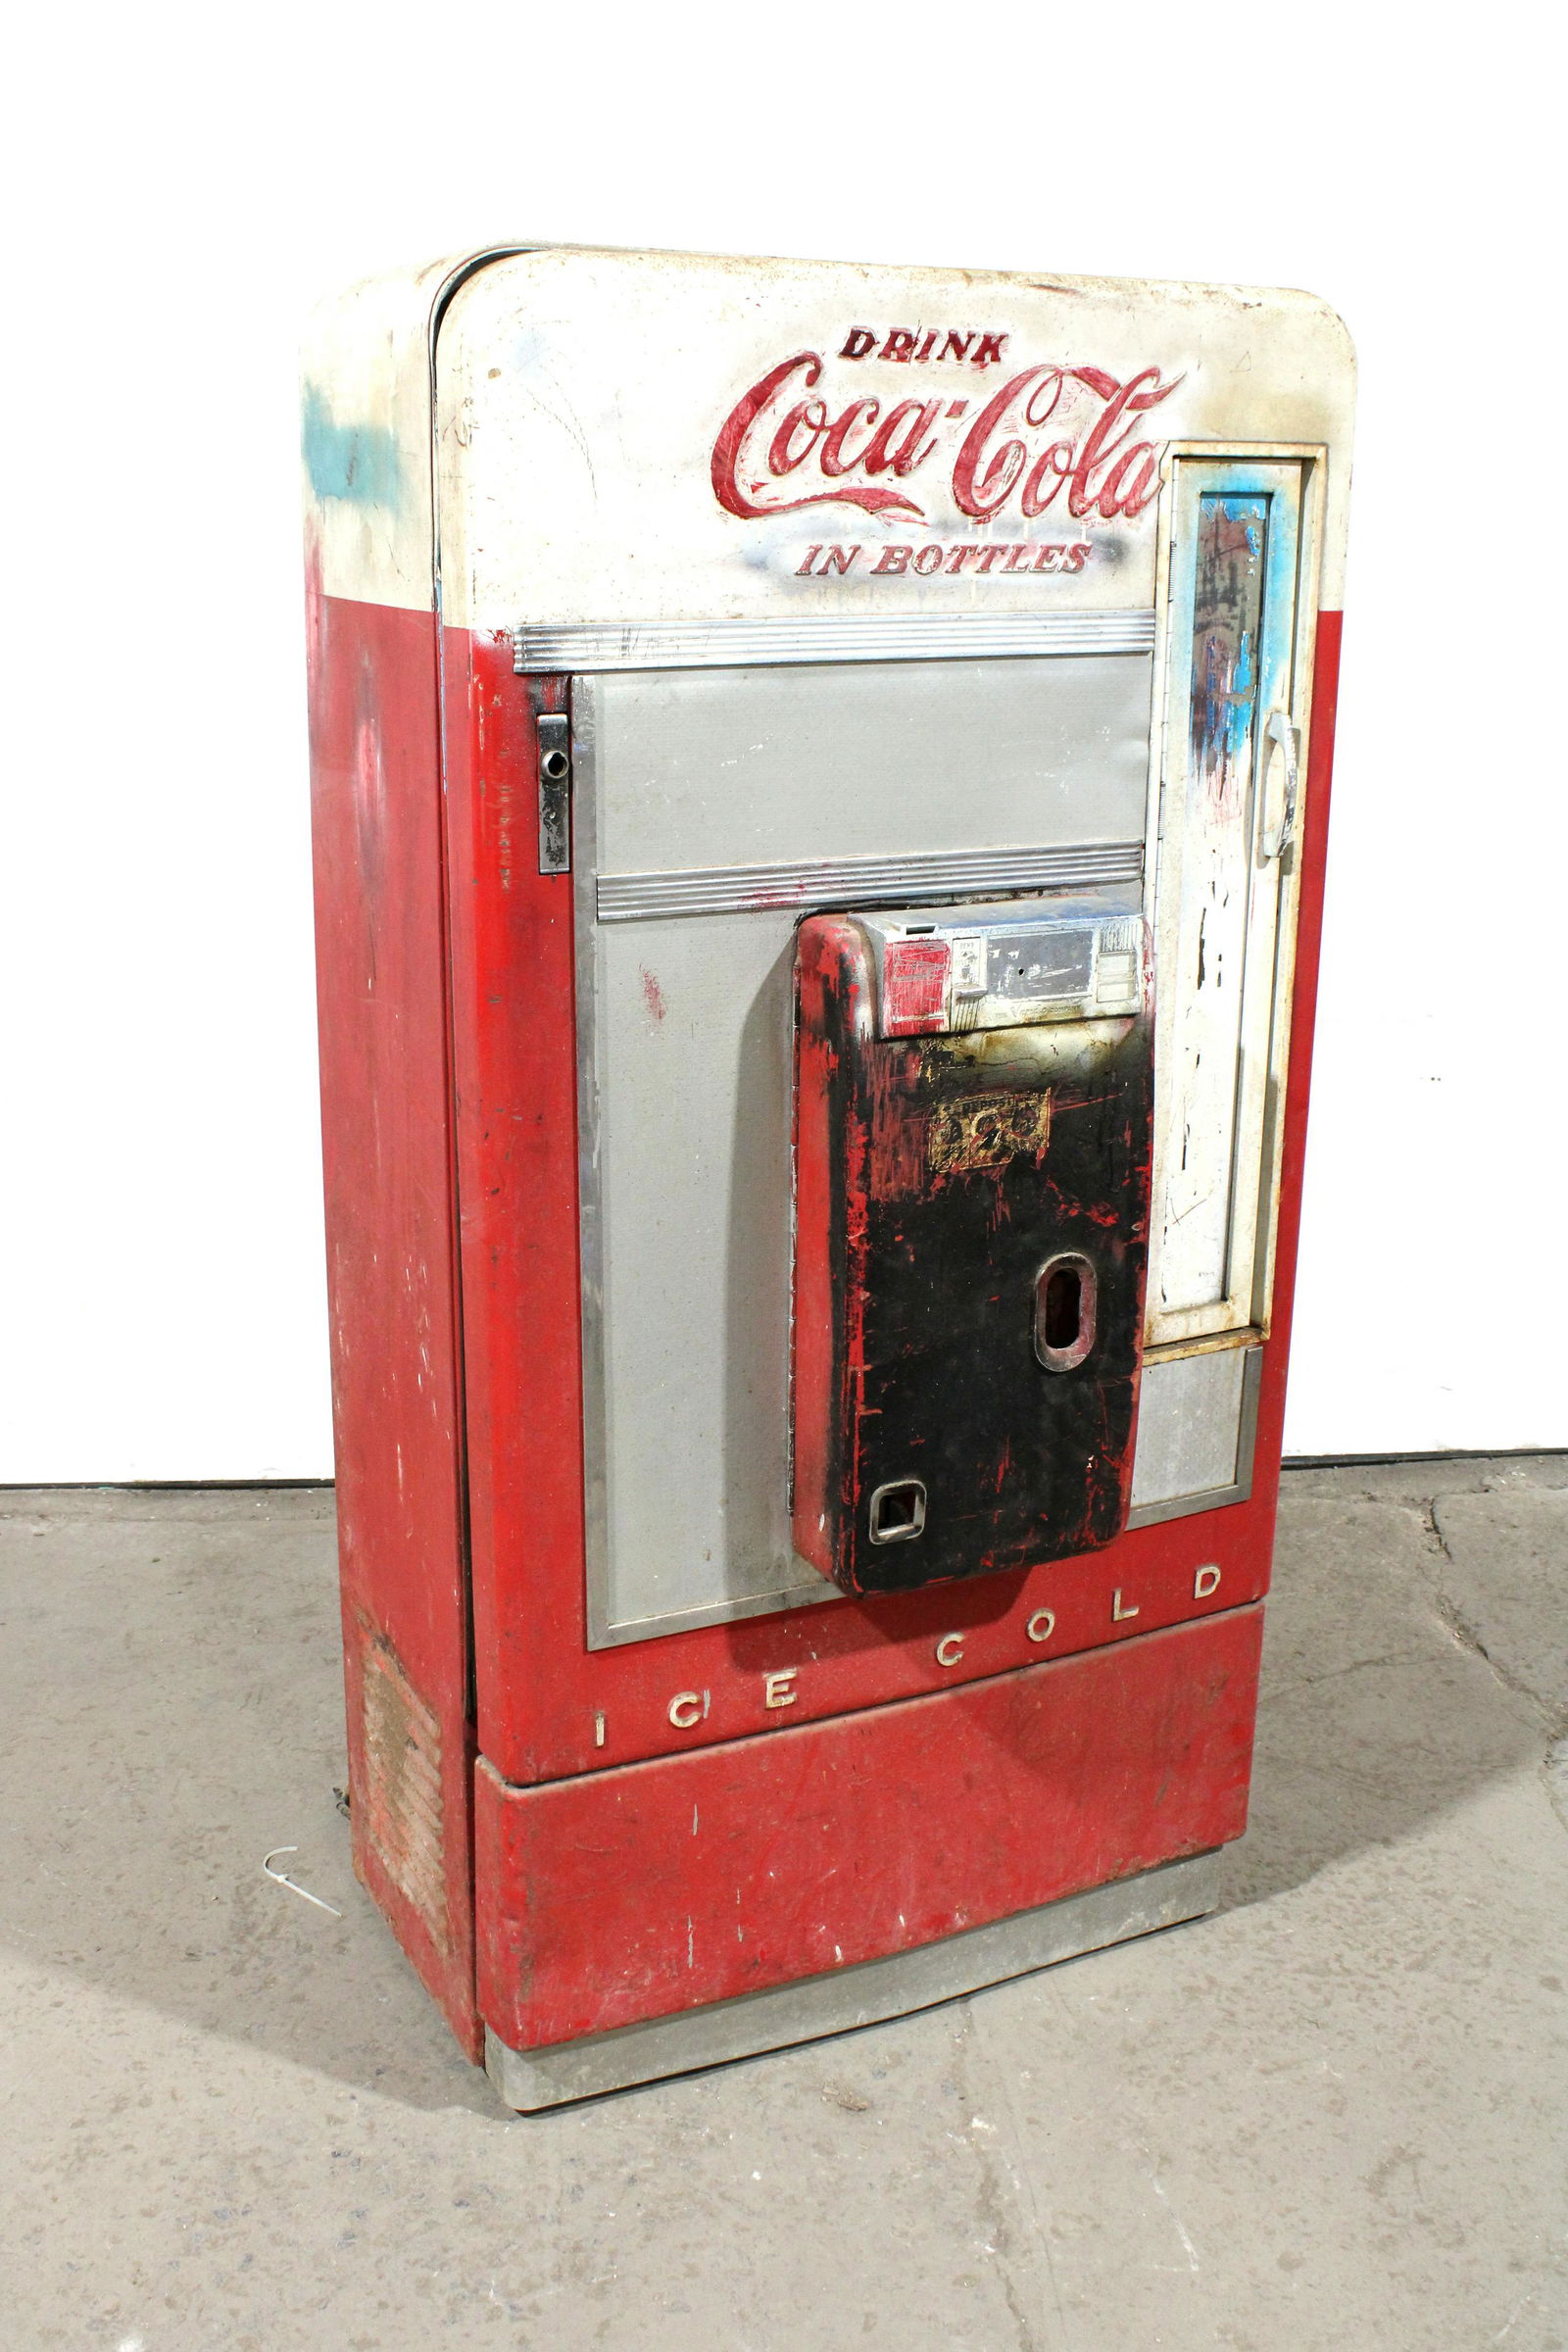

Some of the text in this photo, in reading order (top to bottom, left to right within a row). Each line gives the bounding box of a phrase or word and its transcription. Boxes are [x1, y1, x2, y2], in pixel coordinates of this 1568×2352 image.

[838, 325, 1009, 364] DRINK
[710, 350, 1188, 521] Coca-Cola
[794, 541, 1094, 576] IN BOTTLES
[594, 1564, 1222, 1747] ICE COLD
